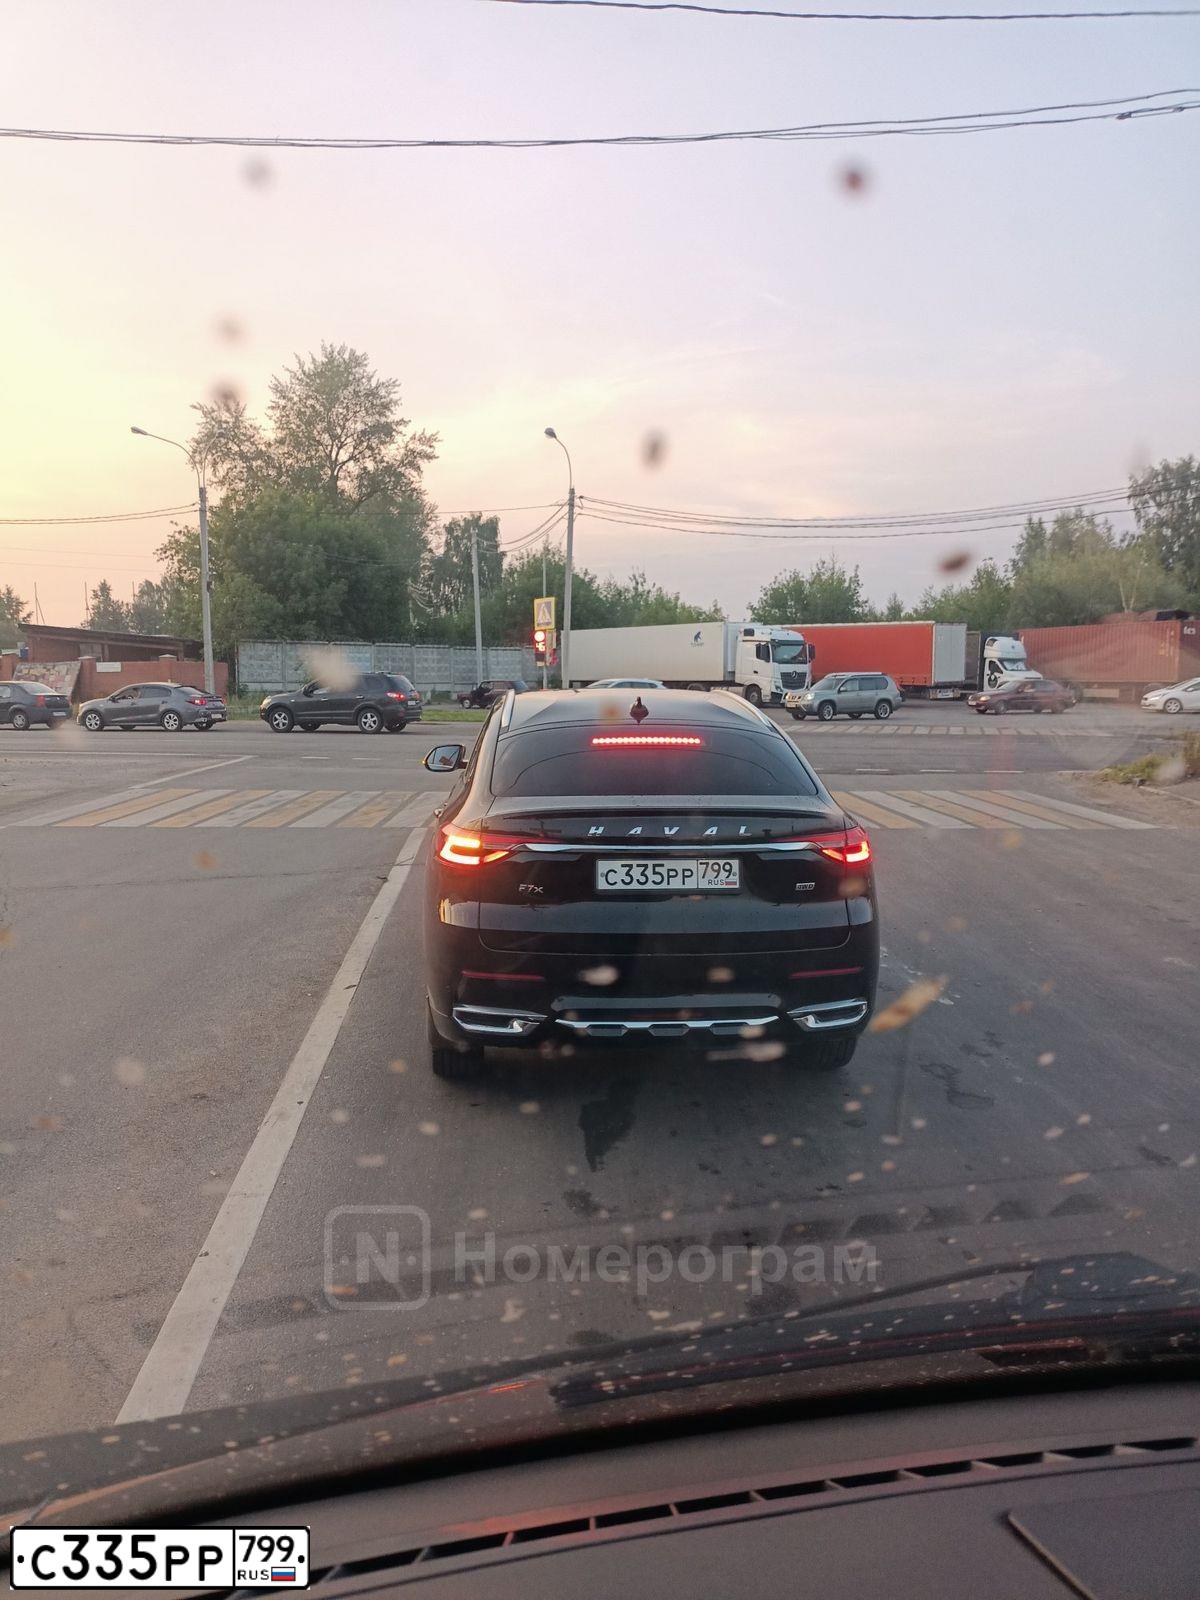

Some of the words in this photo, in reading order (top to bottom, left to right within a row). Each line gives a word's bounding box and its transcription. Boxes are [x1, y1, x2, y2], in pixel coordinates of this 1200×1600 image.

[587, 826, 752, 837] HAVAL
[604, 863, 694, 886] С335РР
[699, 861, 733, 880] 799
